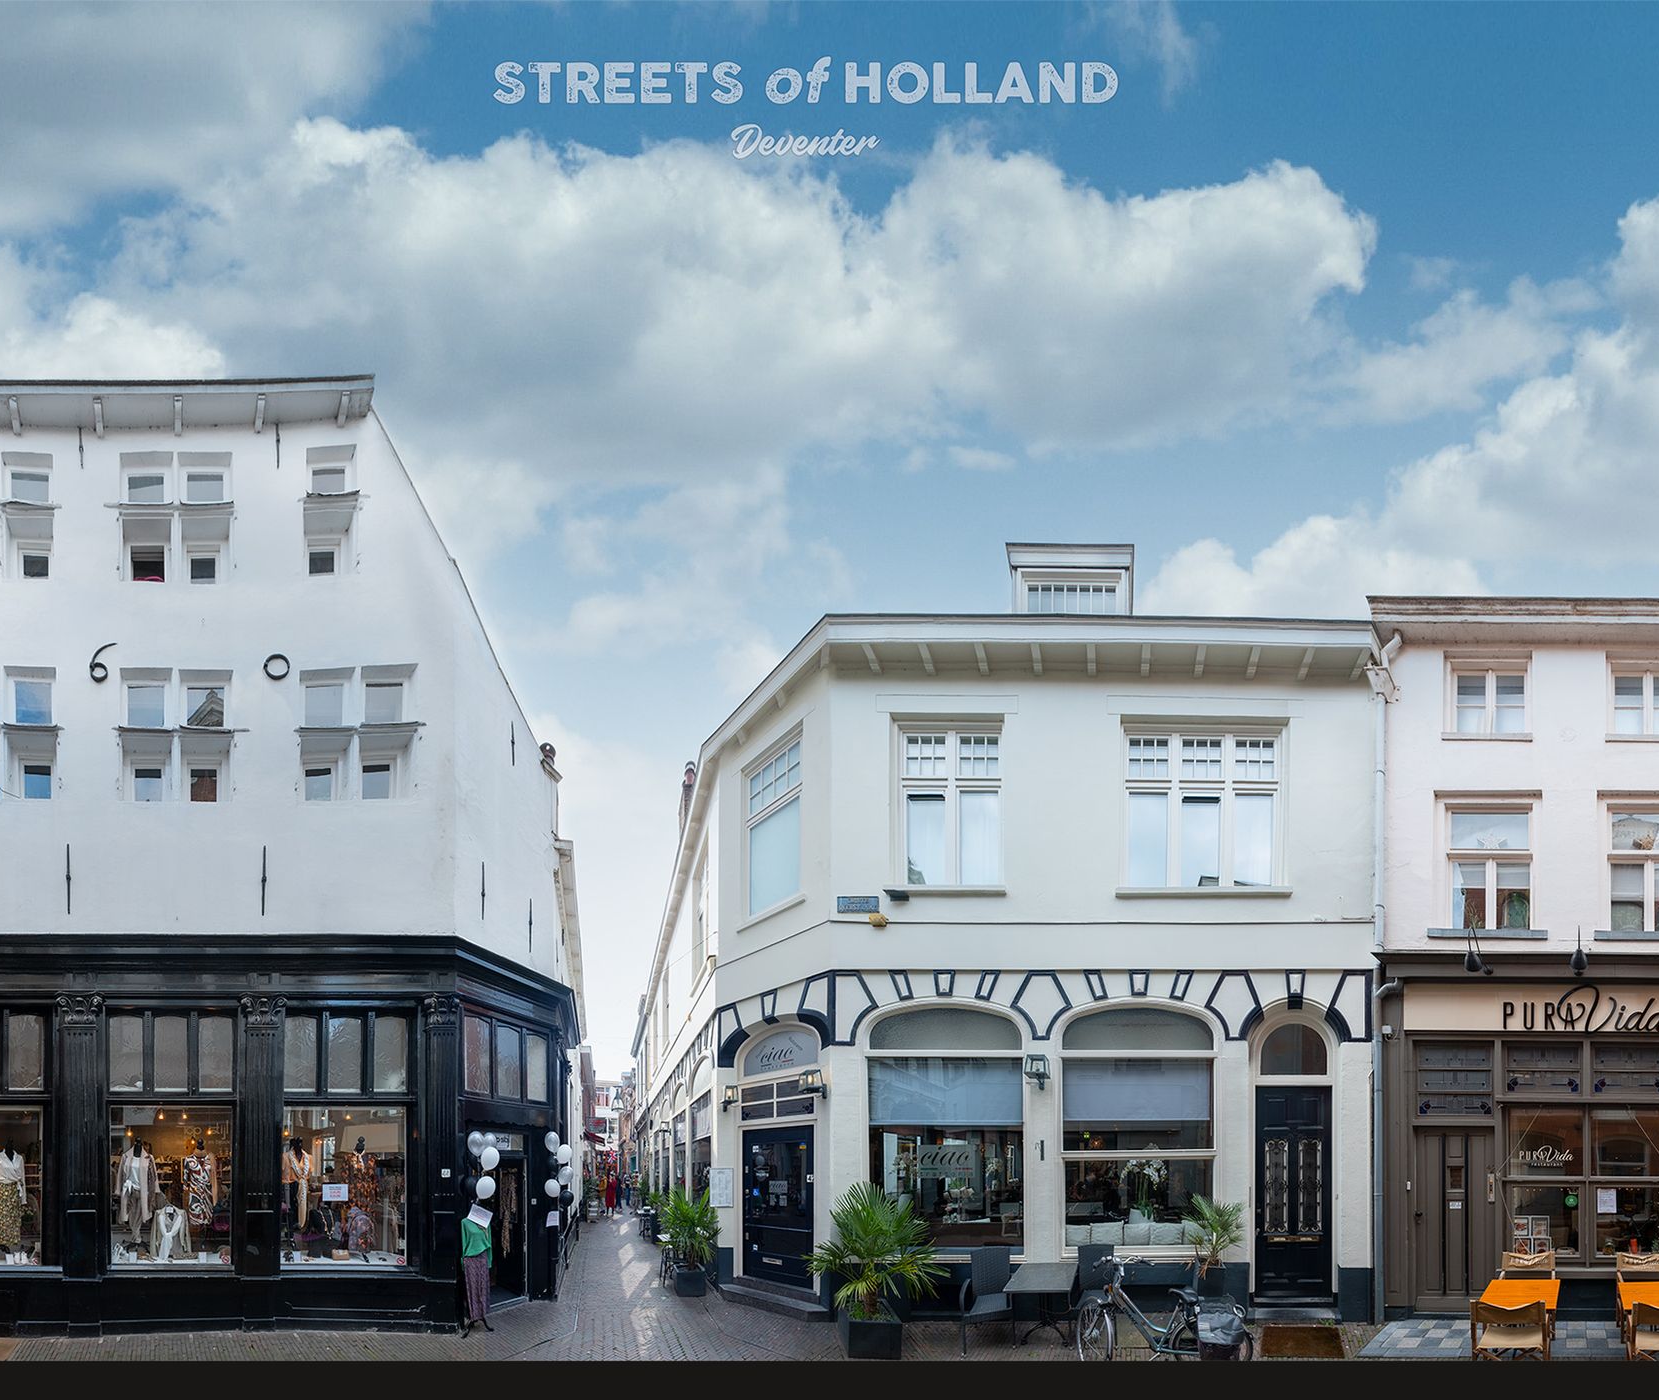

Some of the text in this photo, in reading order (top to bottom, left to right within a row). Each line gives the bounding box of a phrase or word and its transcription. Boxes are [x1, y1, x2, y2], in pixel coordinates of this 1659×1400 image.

[88, 642, 117, 683] 6
[1502, 1001, 1575, 1031] PURA
[761, 1047, 794, 1064] ciao
[921, 1146, 970, 1167] ciao
[1519, 1144, 1574, 1163] PURA Vida
